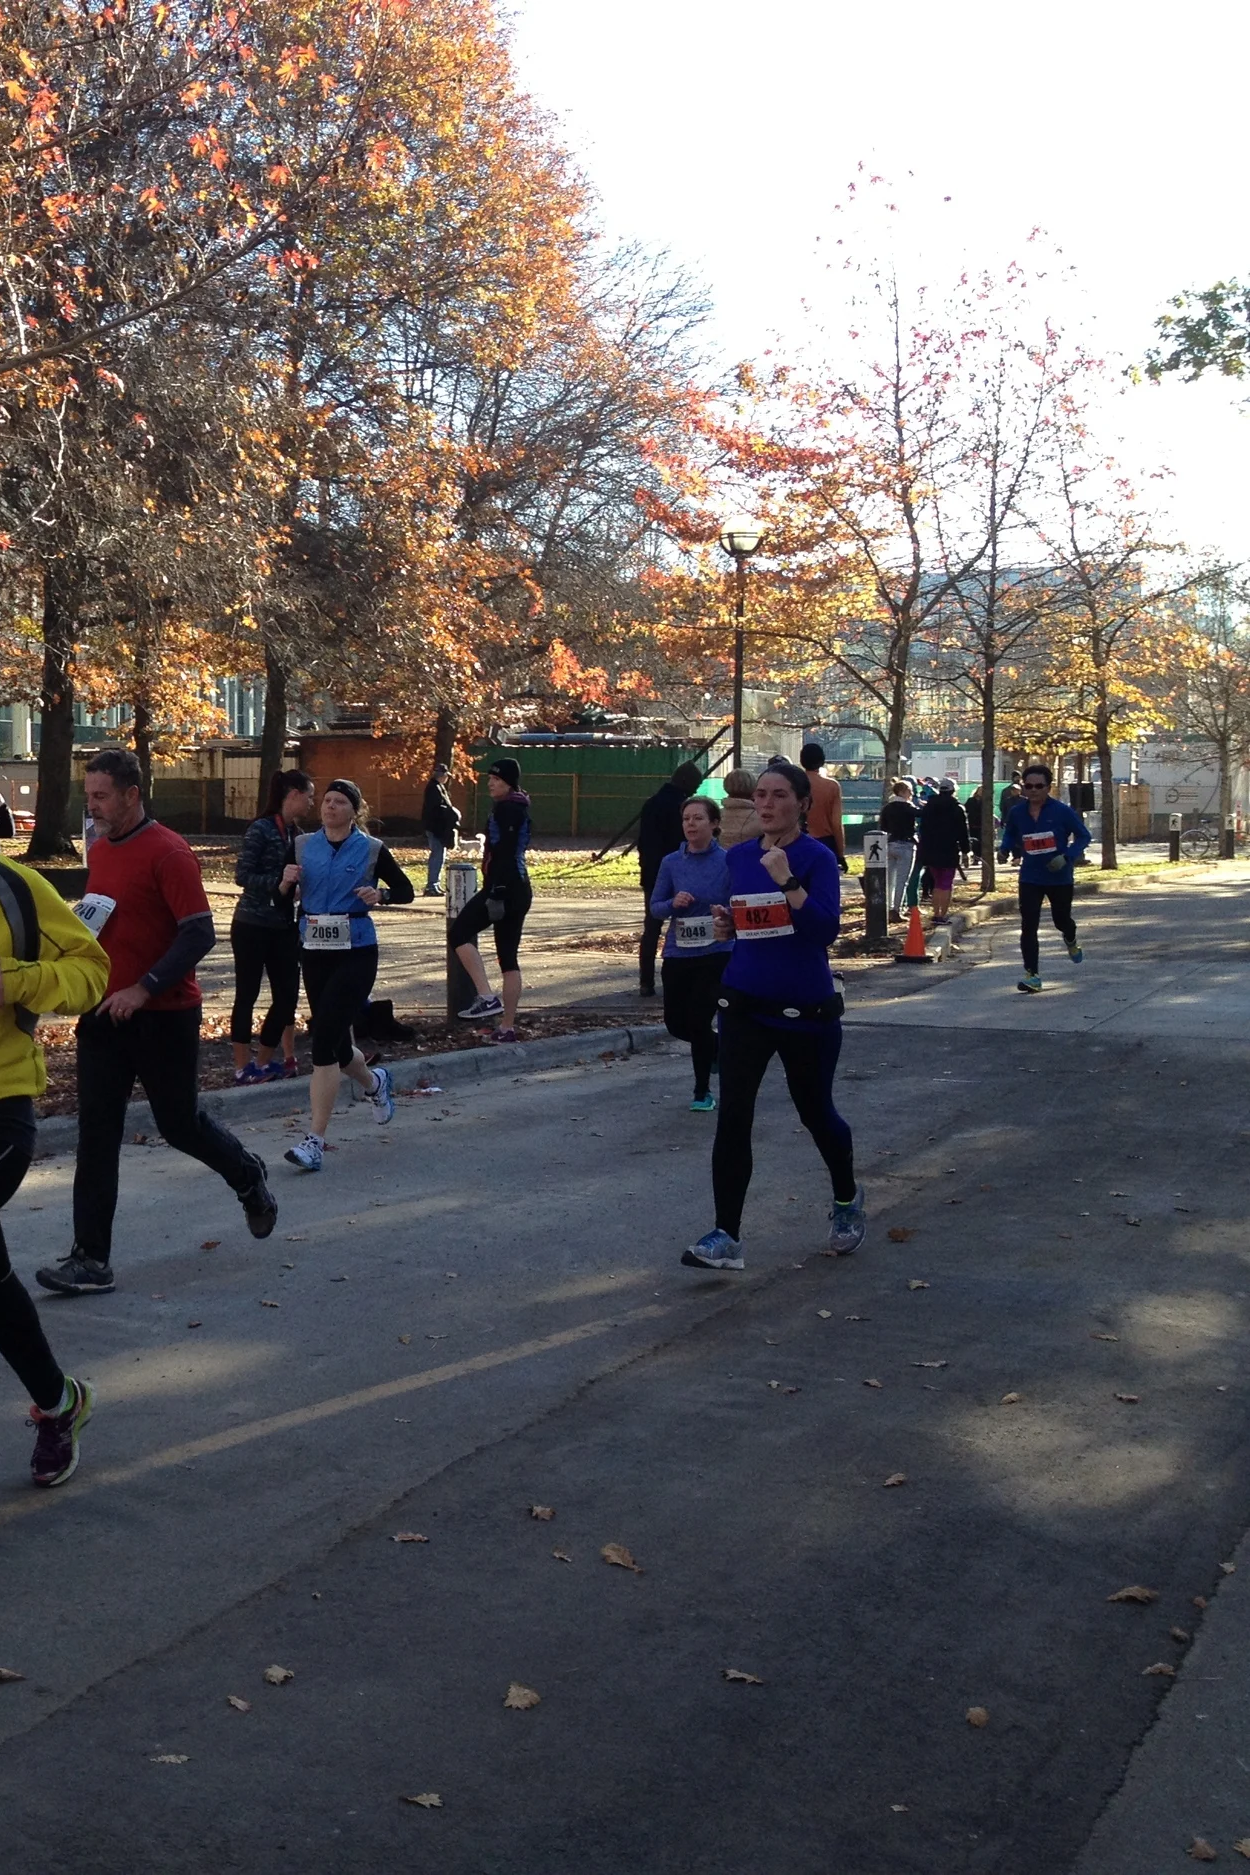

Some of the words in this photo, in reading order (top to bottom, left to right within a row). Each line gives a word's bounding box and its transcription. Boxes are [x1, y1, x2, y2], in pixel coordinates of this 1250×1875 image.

[745, 908, 771, 925] 482
[312, 926, 340, 939] 2069
[680, 926, 707, 938] 2048
